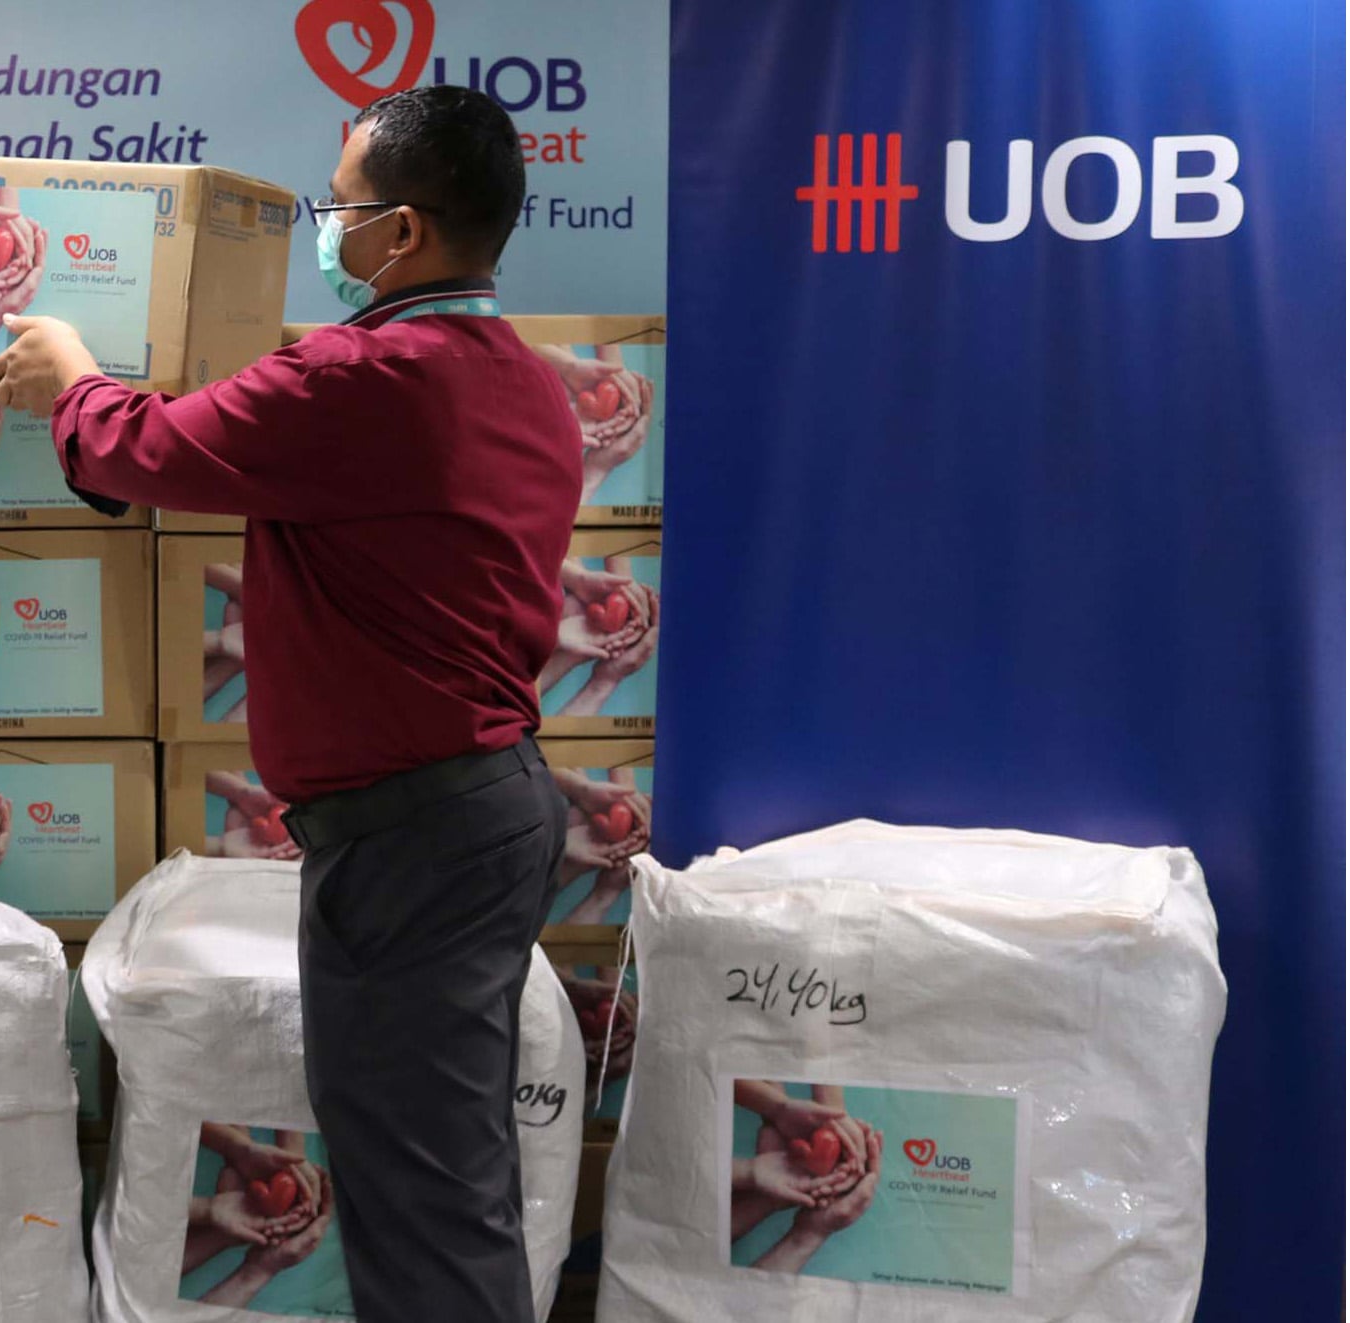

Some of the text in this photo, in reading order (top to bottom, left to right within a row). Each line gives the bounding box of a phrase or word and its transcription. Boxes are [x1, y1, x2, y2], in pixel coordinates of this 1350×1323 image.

[89, 121, 208, 163] Sakit
[944, 134, 1245, 242] UOB
[550, 196, 633, 229] Fund
[88, 248, 117, 261] UOB
[70, 262, 116, 271] Heartbeat
[50, 273, 136, 286] COVID-19 Relief Fund
[0, 510, 27, 521] CHINA
[39, 609, 67, 620] UOB
[52, 813, 81, 825] UOB
[935, 1155, 971, 1171] UOB
[940, 1185, 969, 1195] Relief
[972, 1187, 996, 1199] Fund
